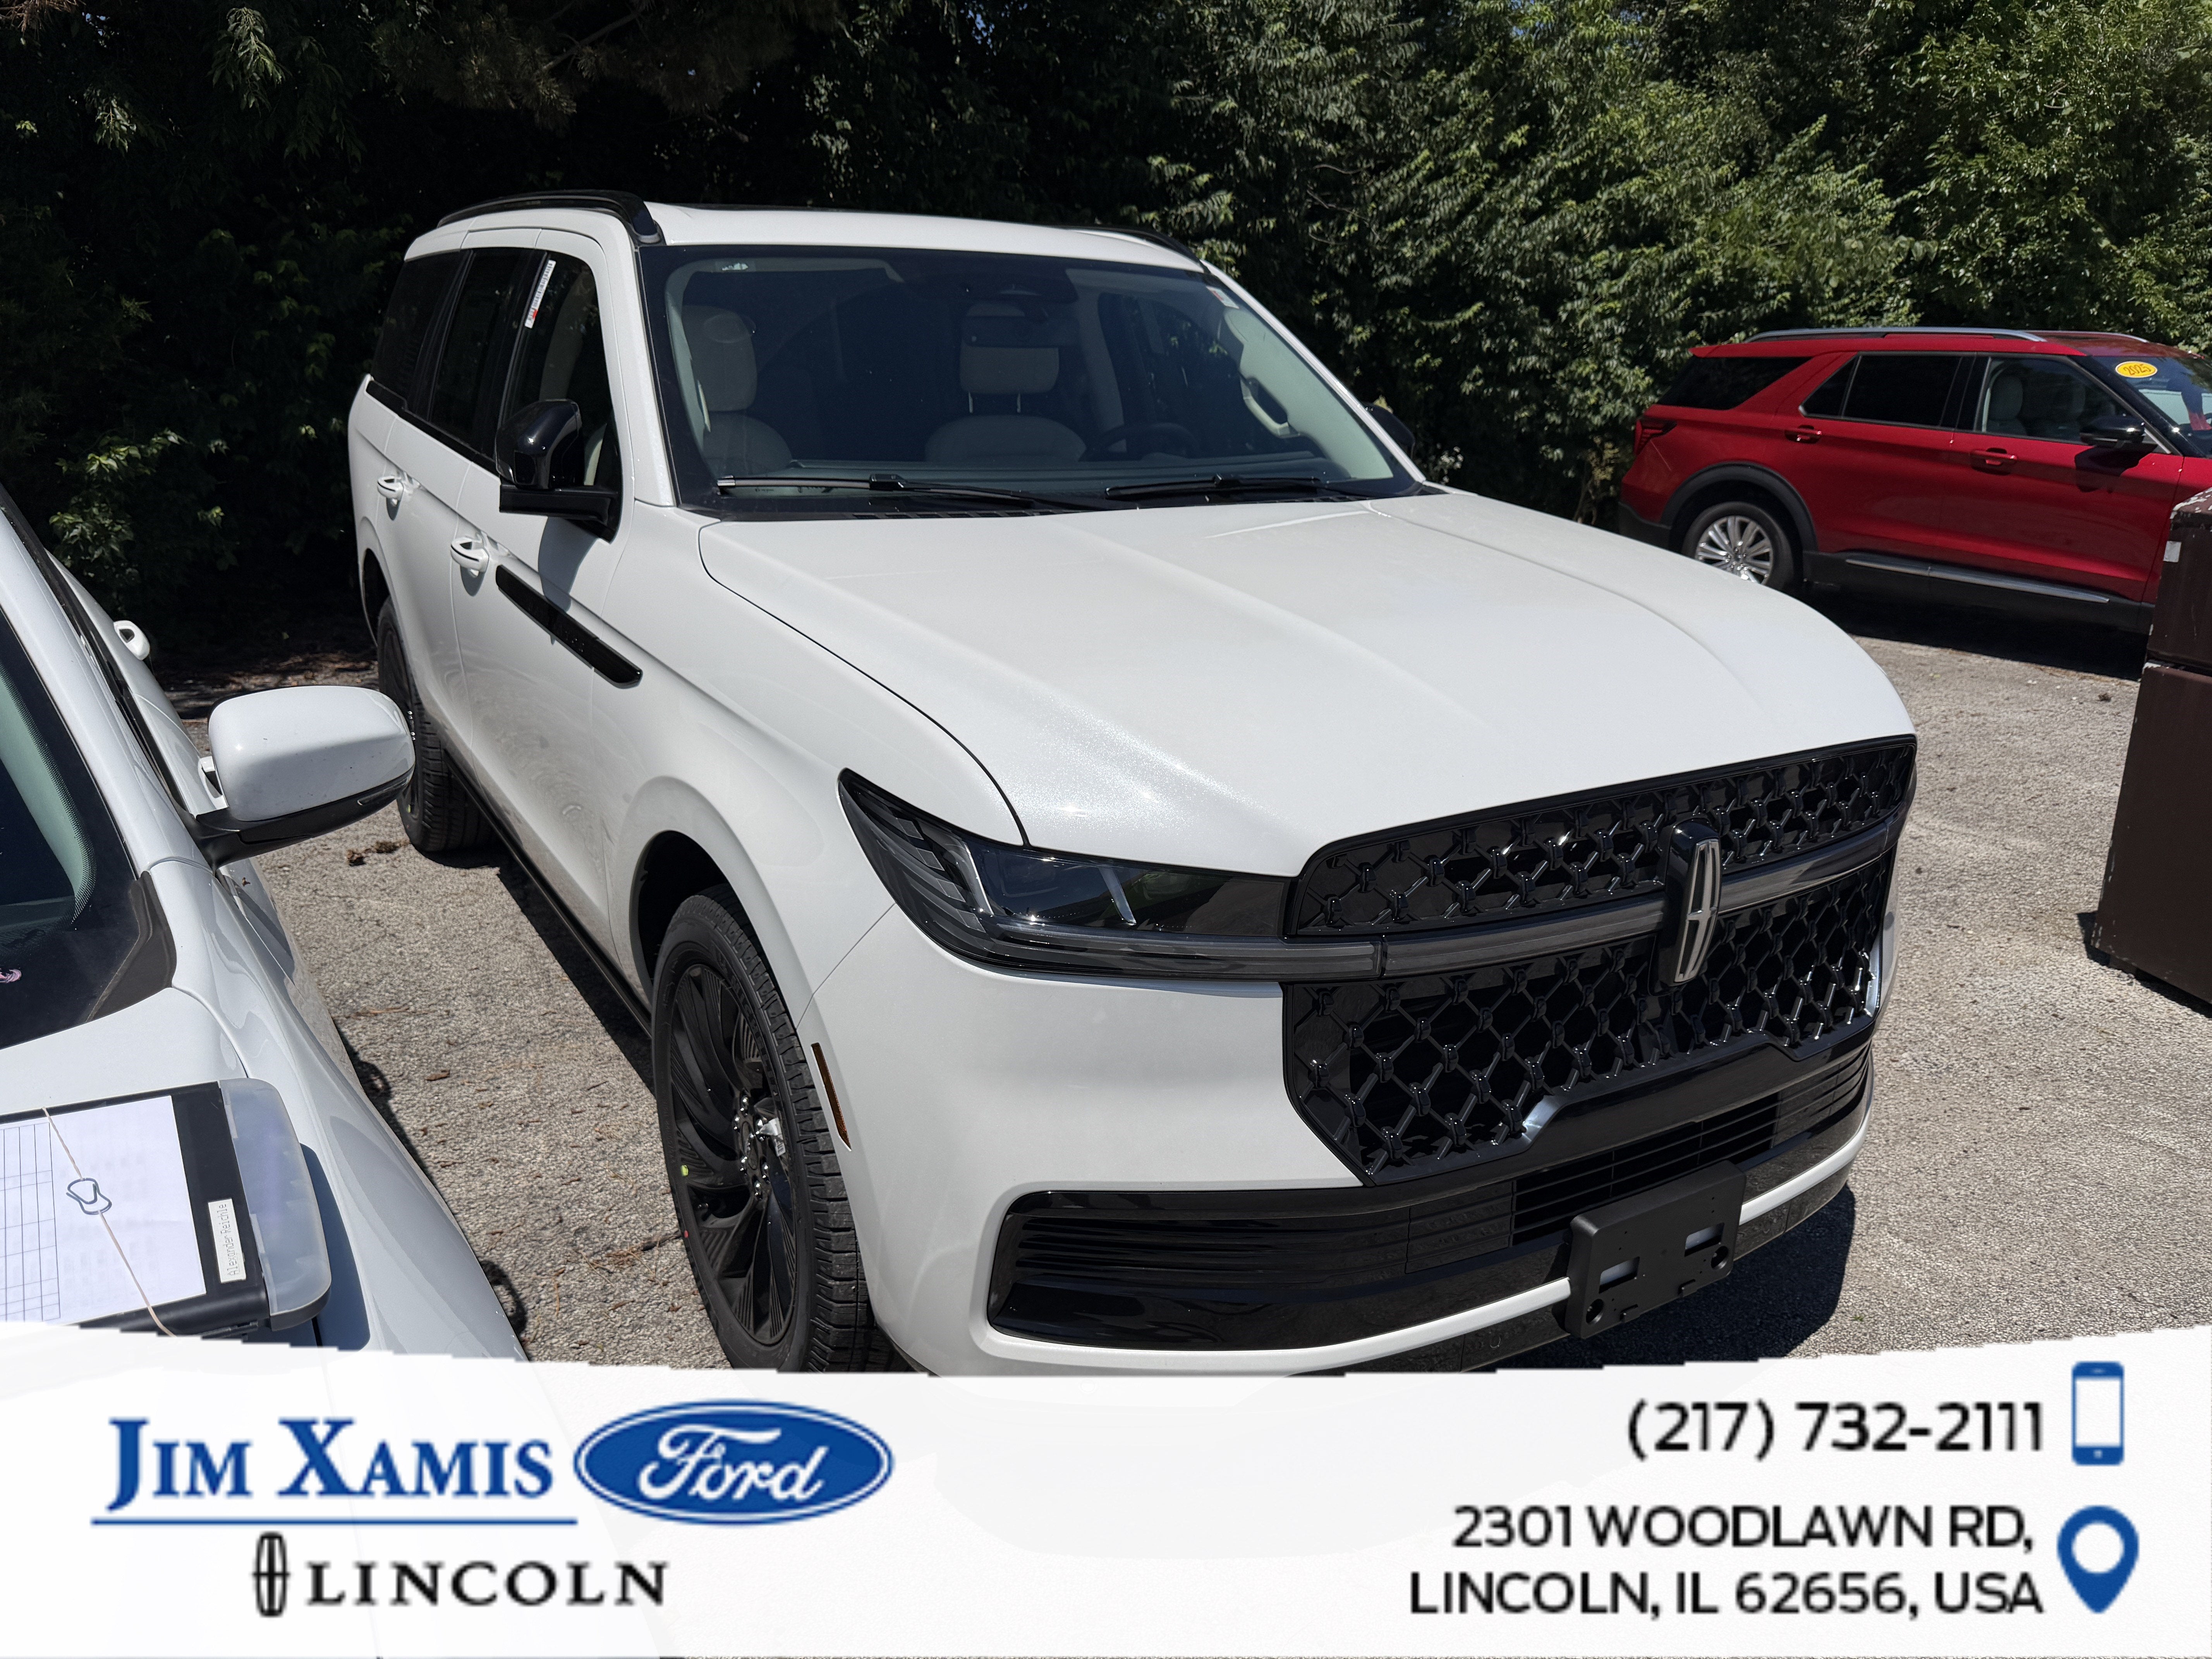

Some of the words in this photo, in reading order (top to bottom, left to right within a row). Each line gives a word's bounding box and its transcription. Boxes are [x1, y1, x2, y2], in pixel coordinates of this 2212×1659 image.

[2123, 364, 2152, 376] 2025
[217, 1203, 232, 1235] Reichle
[223, 1235, 239, 1276] Alexander
